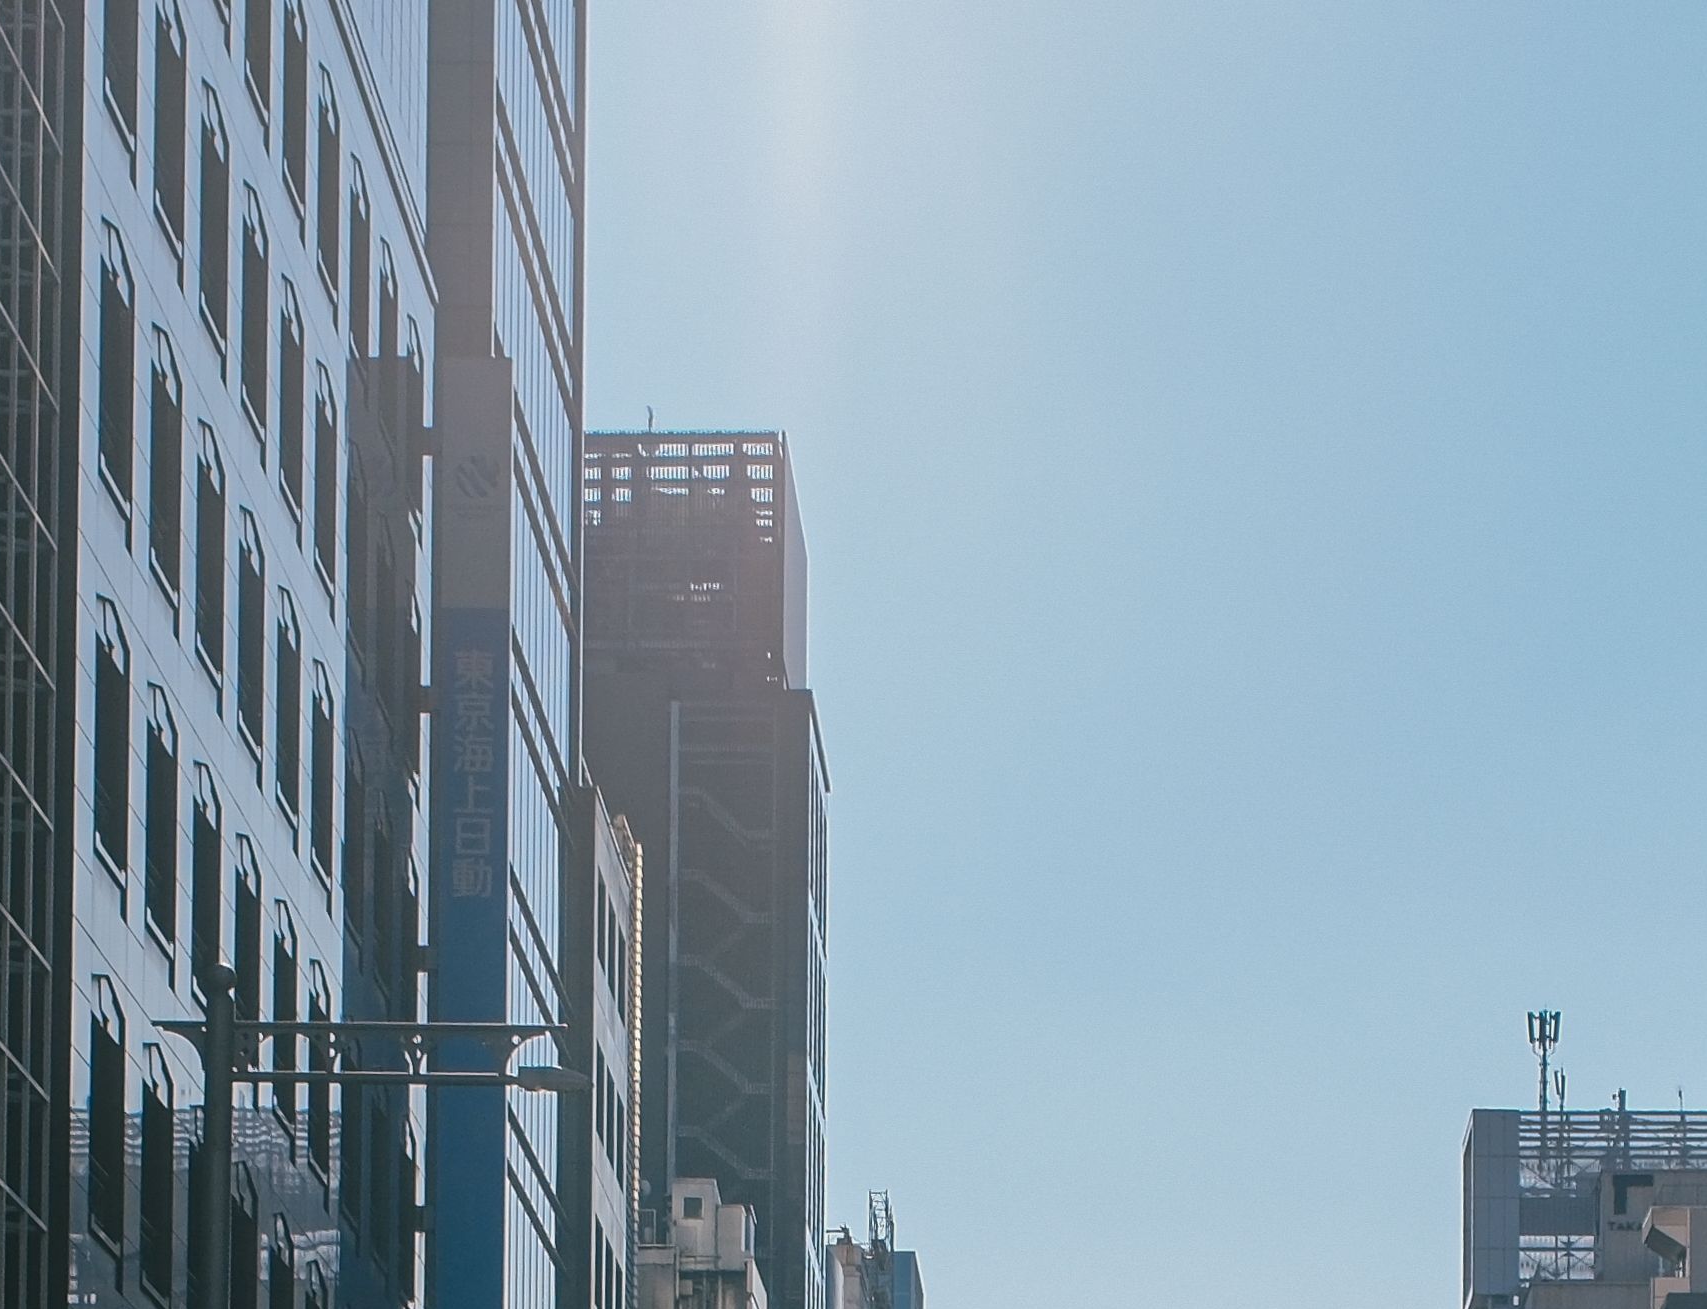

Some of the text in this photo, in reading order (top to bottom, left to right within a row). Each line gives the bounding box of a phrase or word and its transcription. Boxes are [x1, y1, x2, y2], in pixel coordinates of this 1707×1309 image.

[451, 650, 494, 898] 東京海上日動
